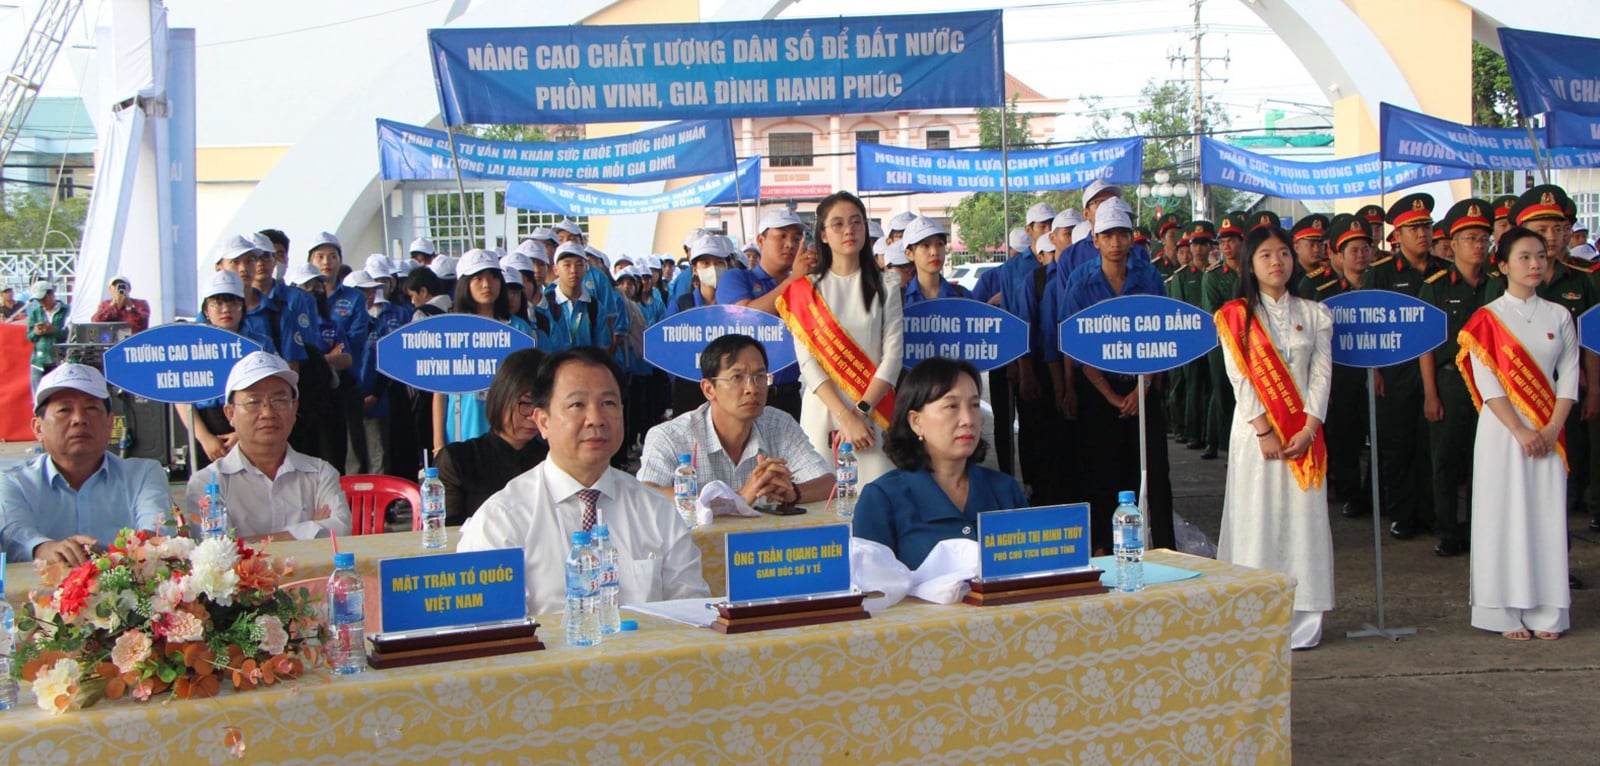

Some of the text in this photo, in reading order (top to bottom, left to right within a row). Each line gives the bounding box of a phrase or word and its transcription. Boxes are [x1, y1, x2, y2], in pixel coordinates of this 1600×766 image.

[467, 25, 965, 71] NÂNG CAO CHẤT LƯỢNG DÂN SỐ ĐỂ ĐẤT NƯỚC
[536, 70, 903, 110] PHỒN VINH, GIA ĐÌNH HẠNH PHÚC
[436, 139, 453, 151] GI
[459, 142, 476, 155] TƯ
[477, 143, 500, 159] VẤN
[503, 147, 518, 161] VÀ
[520, 148, 554, 162] KHÁM
[557, 149, 579, 162] SỨC
[653, 133, 676, 152] HÔN
[678, 126, 707, 146] NHÂN
[1447, 131, 1499, 149] KHÔNG
[875, 151, 932, 169] NGHIÊM
[1007, 156, 1049, 171] CHỌN
[1053, 150, 1086, 167] GIỚI
[1089, 145, 1126, 163] TÍNH
[1398, 140, 1456, 161] KHÔNG
[1575, 151, 1600, 166] TÍN
[487, 163, 505, 175] LAI
[507, 165, 539, 179] HẠNH
[541, 167, 573, 179] PHÚC
[576, 163, 600, 179] CỦA
[627, 160, 647, 176] GIA
[649, 154, 676, 173] ĐÌNH
[886, 170, 913, 185] KHI
[917, 174, 953, 187] SINH
[957, 174, 995, 188] DƯỚI
[1033, 171, 1071, 186] HÌNH
[1074, 164, 1114, 183] THỨC
[1221, 167, 1236, 181] LÀ
[1395, 167, 1418, 184] DÂN
[903, 314, 1003, 333] TRƯỜNG THPT
[1076, 308, 1201, 334] TRƯỜNG CAO ĐẲNG
[1332, 306, 1425, 324] ƯỜNG THCS & THPT
[401, 329, 511, 349] TRƯỜNG THPT CHUYÊN
[662, 323, 702, 342] TRƯỜNG
[705, 325, 725, 342] CAO
[1356, 331, 1377, 350] VĂN
[1379, 330, 1402, 352] KIỆT
[123, 337, 243, 363] TRƯỜNG CAO ĐẲNG Y TẾ
[905, 339, 999, 359] PHÓ CƠ ĐIỀU
[1102, 340, 1178, 360] KIÊN GIANG
[416, 357, 450, 376] HUỲNH
[477, 358, 498, 378] ĐẠT
[156, 369, 214, 389] KIÊN GIANG
[733, 550, 754, 566] ÔNG
[757, 545, 783, 564] TRẦN
[786, 546, 818, 563] QUANG
[392, 564, 514, 593] MẶT TRẬN TỔ QUỐC
[424, 593, 484, 613] VIỆT NAM
